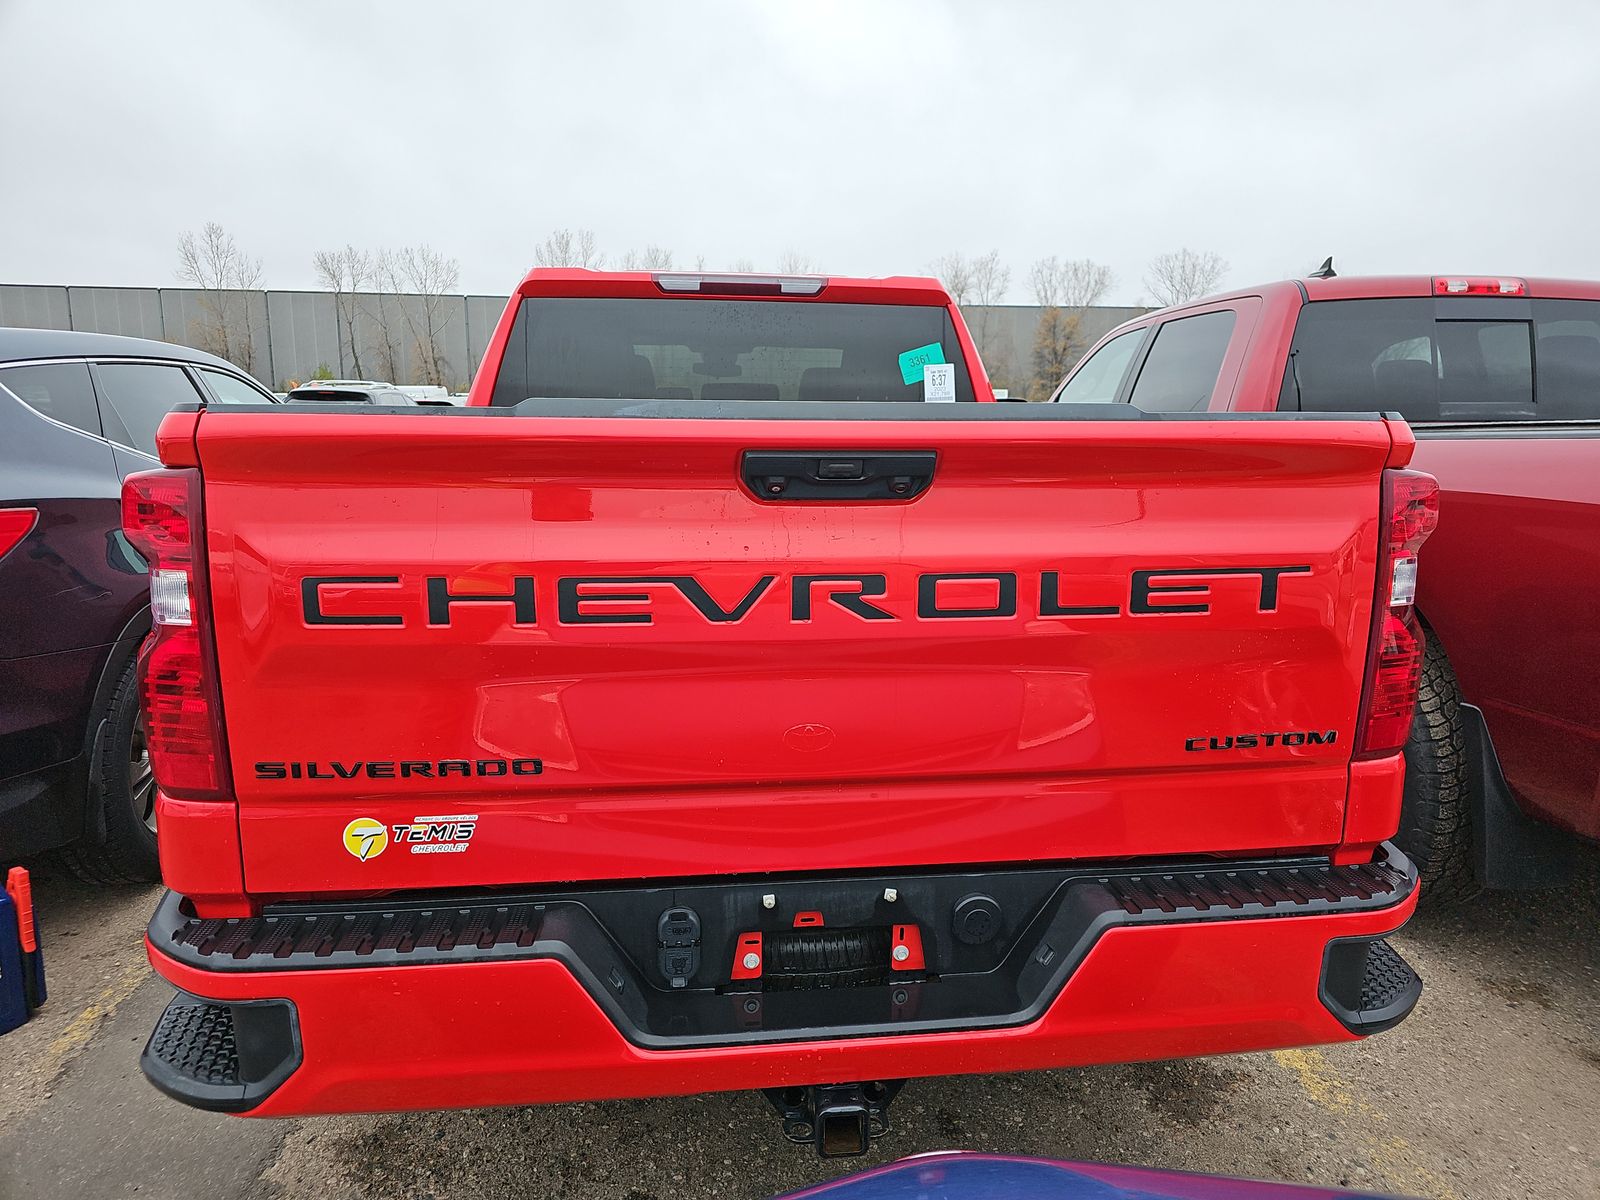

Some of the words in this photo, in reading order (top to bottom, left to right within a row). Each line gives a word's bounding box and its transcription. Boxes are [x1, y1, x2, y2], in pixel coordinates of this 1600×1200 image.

[909, 353, 930, 367] 3361
[931, 374, 947, 387] 6:37
[302, 566, 1312, 627] CHEVROLET
[1184, 730, 1338, 752] CUSTOM
[254, 758, 544, 779] SILVERADO
[393, 824, 475, 841] TEMIS
[412, 844, 469, 853] CHEVROLET
